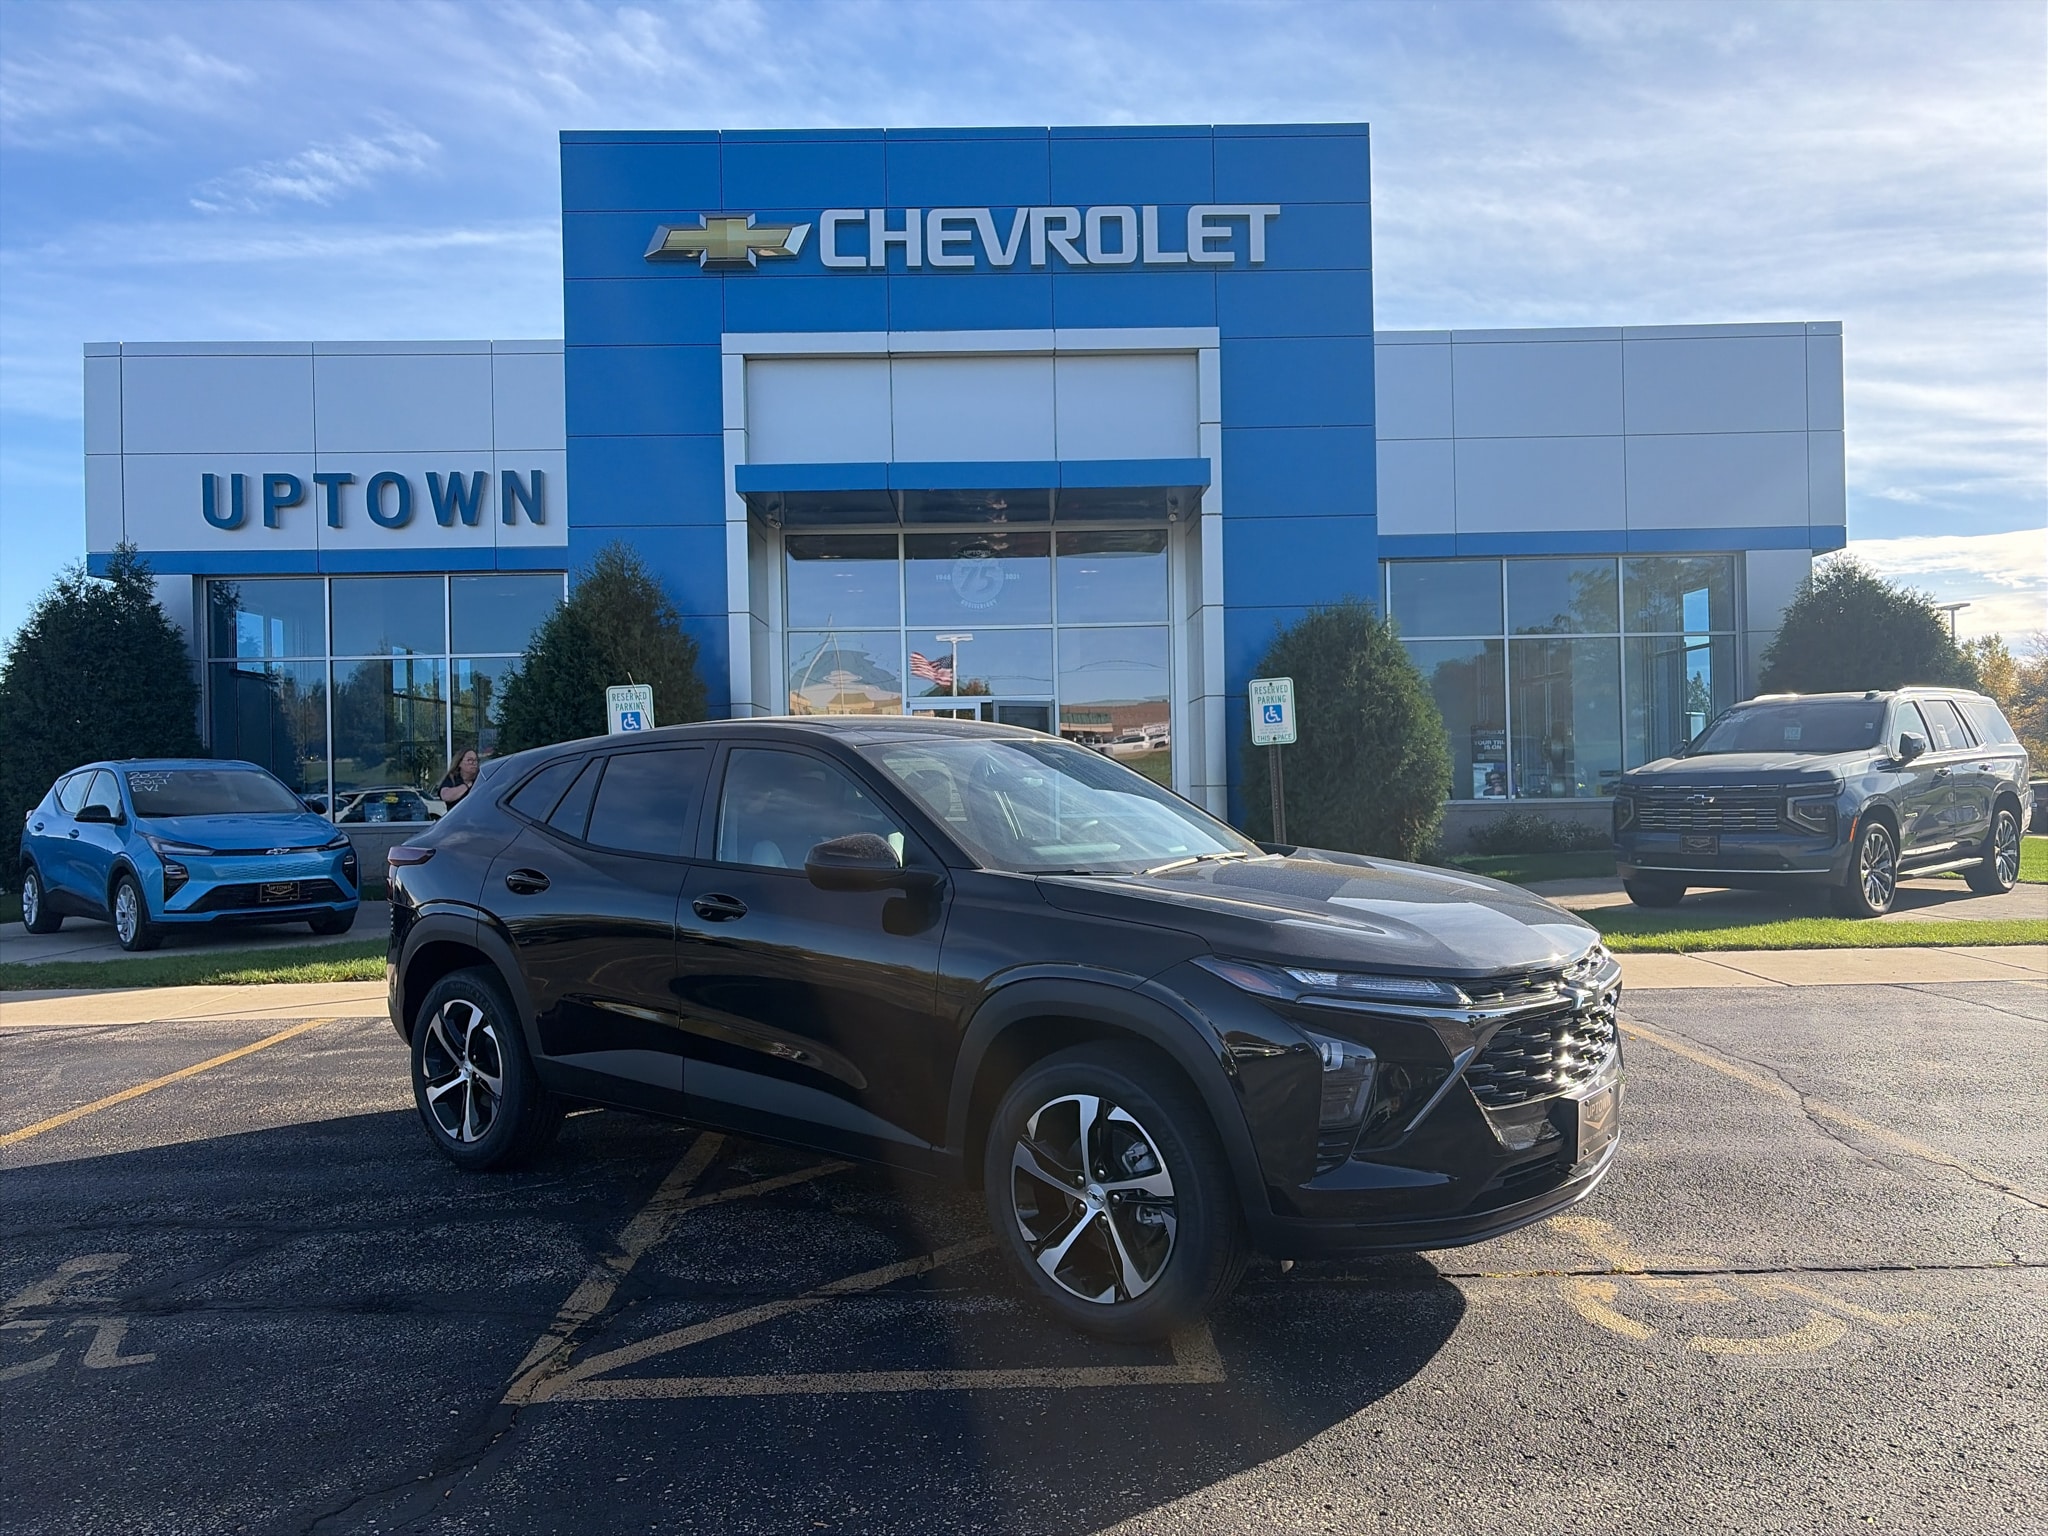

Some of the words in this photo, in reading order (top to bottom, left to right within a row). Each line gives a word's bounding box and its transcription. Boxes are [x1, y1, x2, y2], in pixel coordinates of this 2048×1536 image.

[819, 204, 1281, 268] CHEVROLET
[201, 469, 546, 531] UPTOWN
[959, 566, 996, 594] 75
[611, 691, 647, 702] RESERVED
[1254, 684, 1289, 695] RESERVED
[1257, 694, 1287, 704] PARKING
[129, 771, 173, 780] 2027
[1586, 1094, 1611, 1119] UPTOWN
